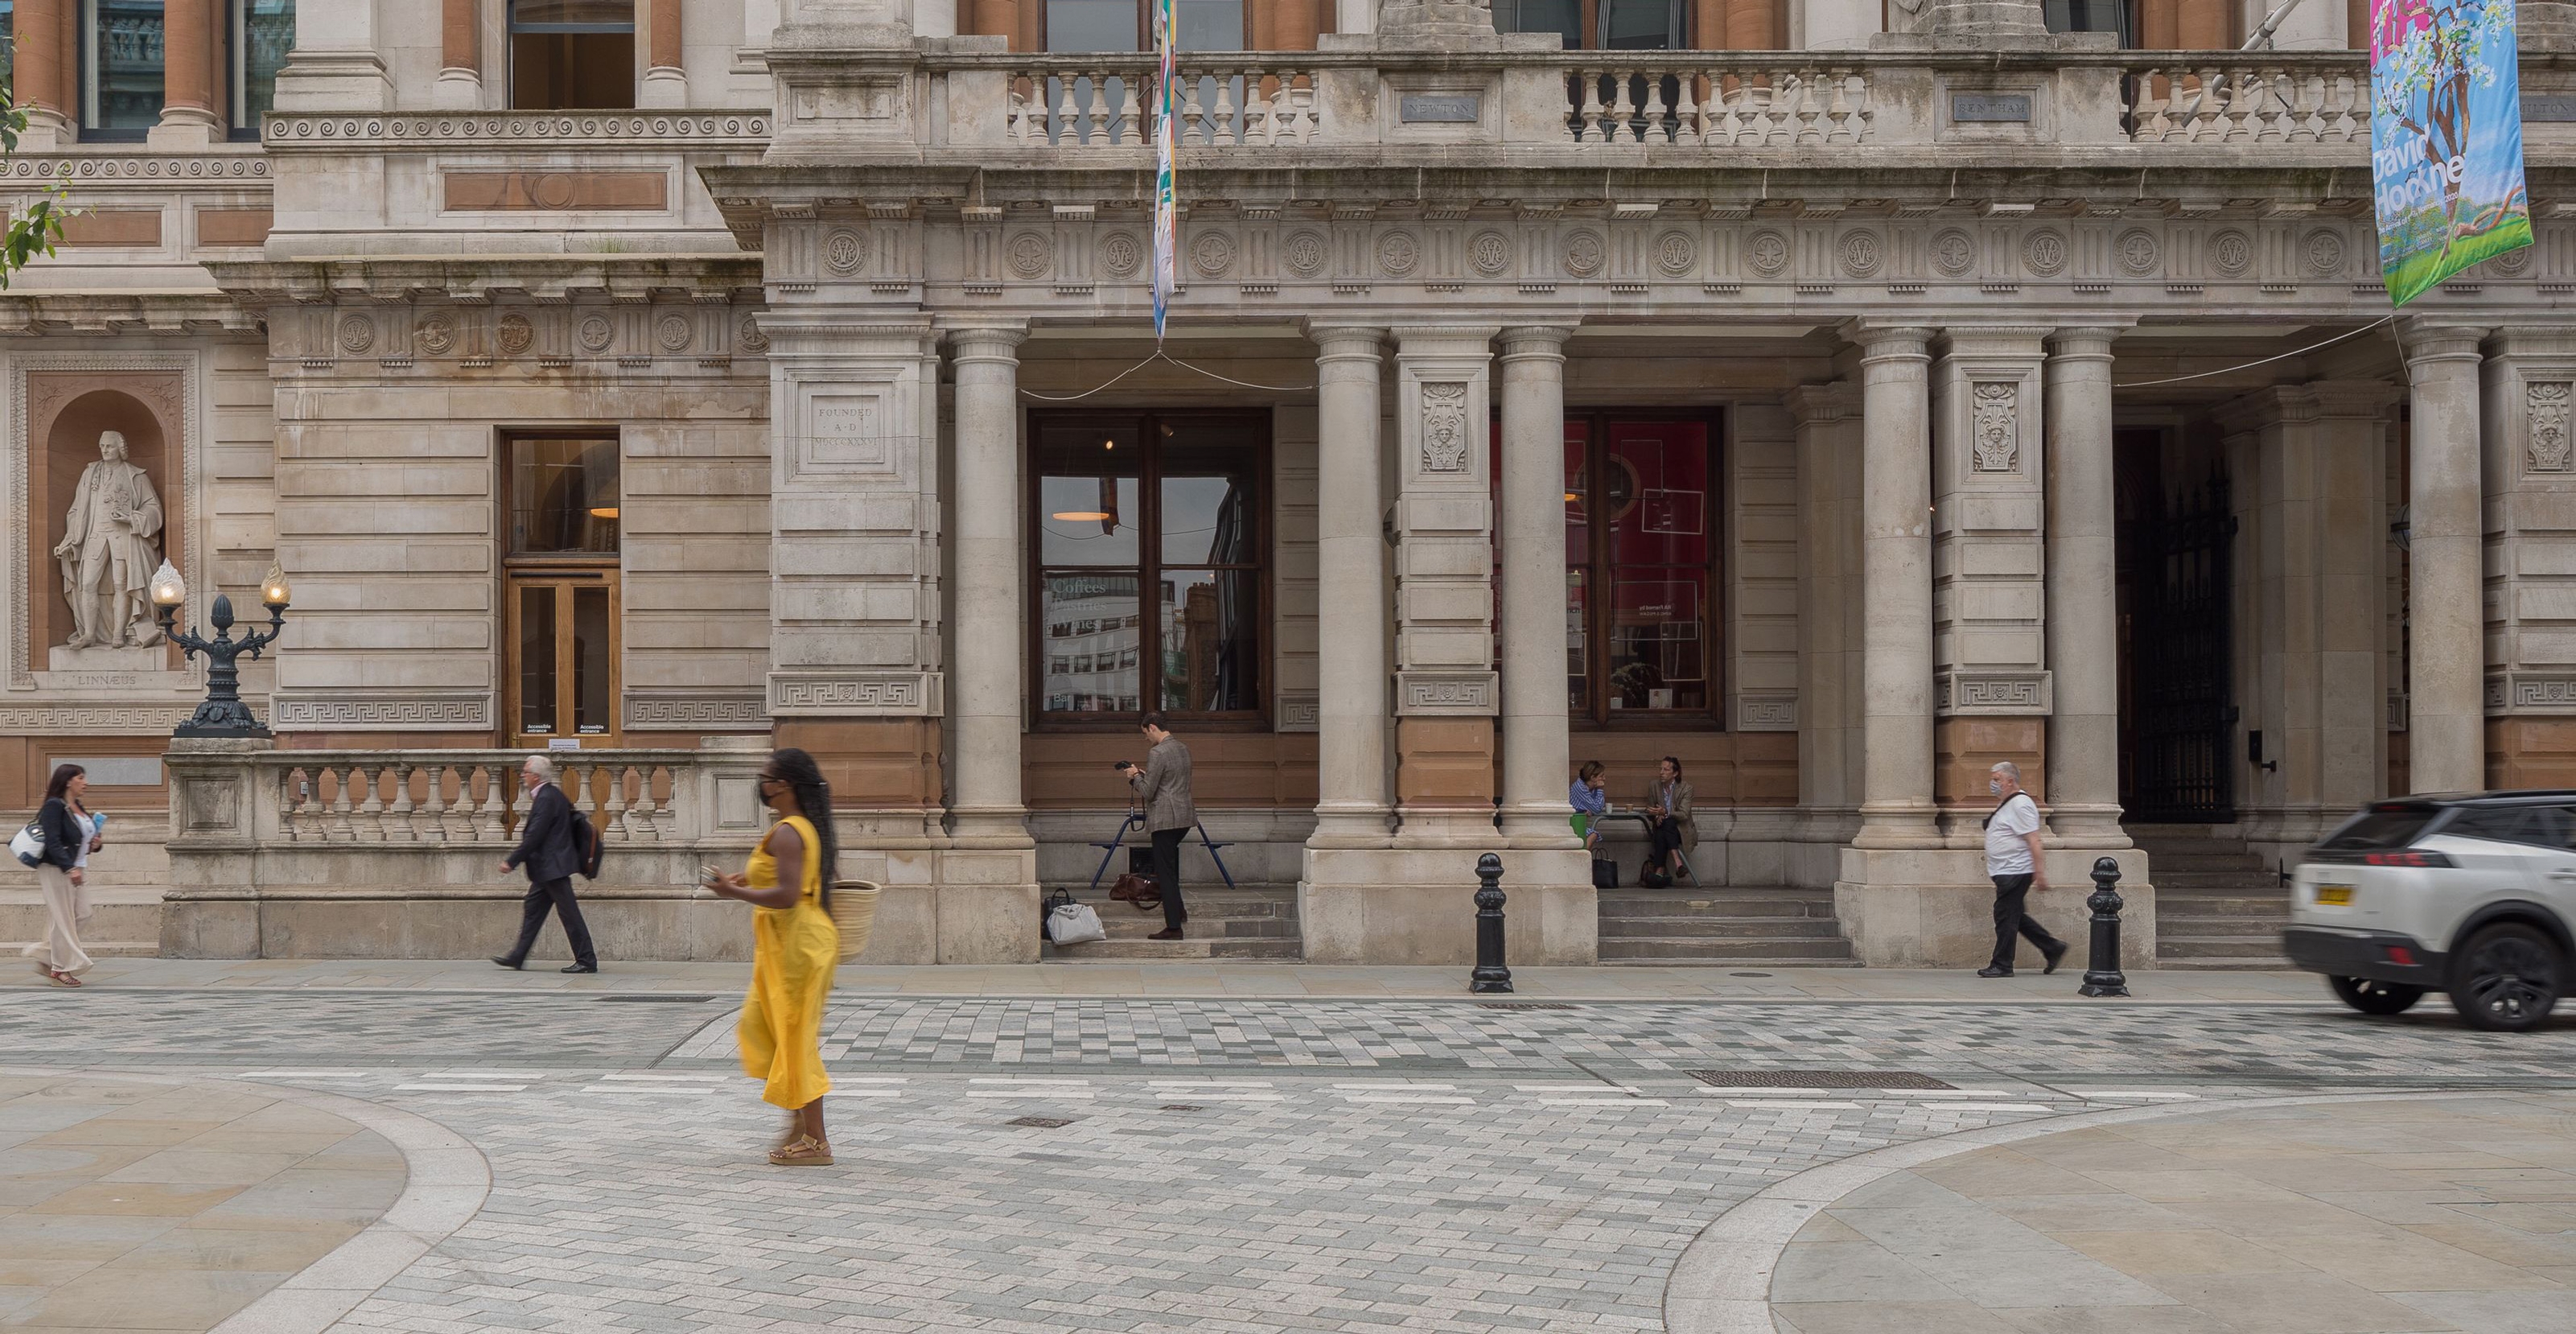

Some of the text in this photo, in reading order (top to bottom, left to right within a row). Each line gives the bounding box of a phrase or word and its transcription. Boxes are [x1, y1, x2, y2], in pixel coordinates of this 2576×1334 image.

[1409, 104, 1470, 113] NEWTON
[1958, 103, 2025, 113] BENTHAM
[2372, 123, 2430, 184] David
[2374, 154, 2464, 220] Hockne
[819, 409, 872, 417] FOUNDED
[1053, 579, 1107, 594] Coffees
[1053, 598, 1108, 611] Pastries
[78, 676, 136, 685] LINNÆUS
[1053, 693, 1071, 702] Bar
